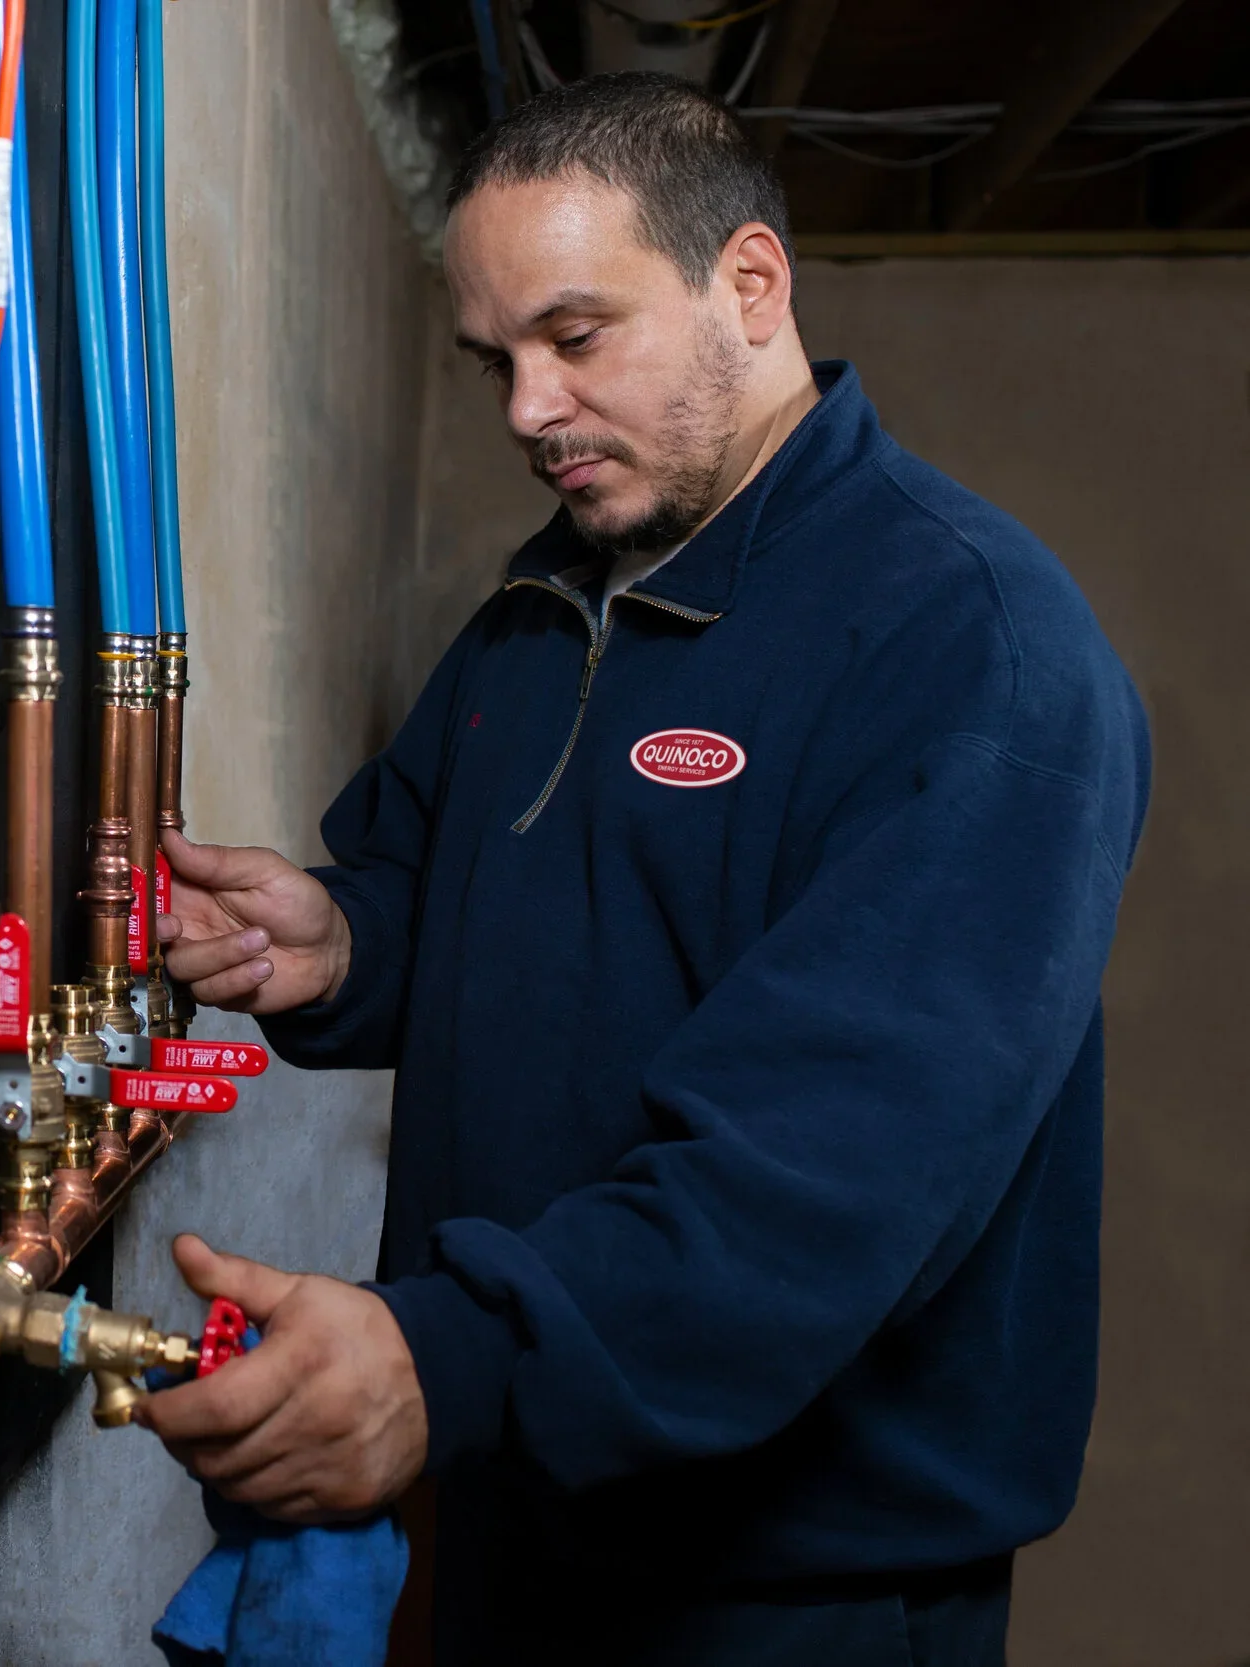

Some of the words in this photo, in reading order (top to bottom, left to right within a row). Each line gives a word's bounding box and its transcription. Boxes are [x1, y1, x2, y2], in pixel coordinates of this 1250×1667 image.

[644, 745, 727, 769] QUINOCO
[679, 767, 706, 776] SERVICES
[129, 914, 138, 936] RWV
[192, 1053, 217, 1066] RWV
[155, 1087, 182, 1100] RWV
